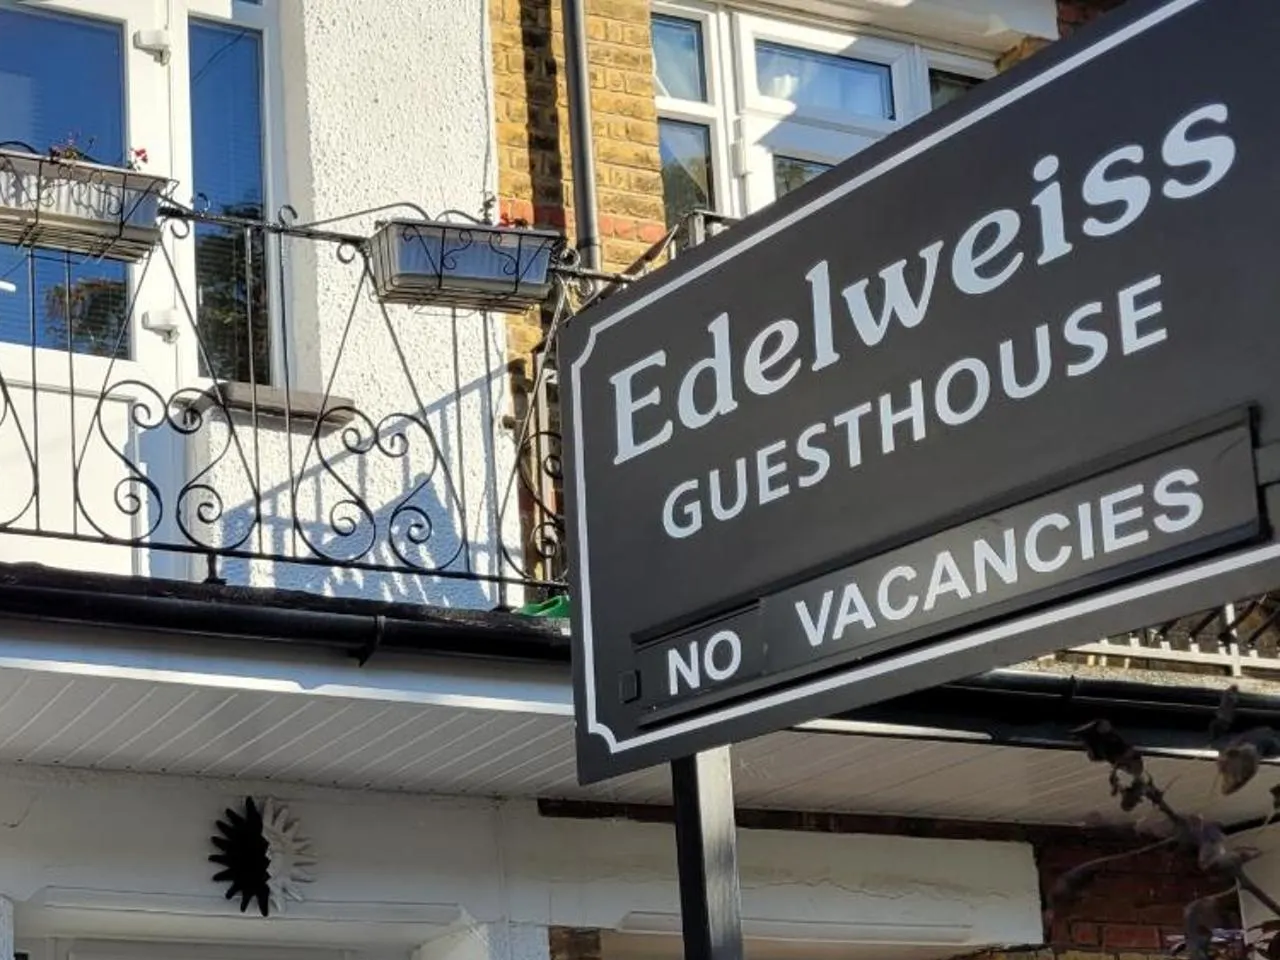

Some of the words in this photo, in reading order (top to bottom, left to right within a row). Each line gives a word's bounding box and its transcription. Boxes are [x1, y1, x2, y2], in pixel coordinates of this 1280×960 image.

[609, 103, 1236, 465] Edelweiss
[662, 274, 1168, 539] GUESTHOUSE
[667, 630, 743, 696] NO
[795, 468, 1204, 647] VACANCIES
